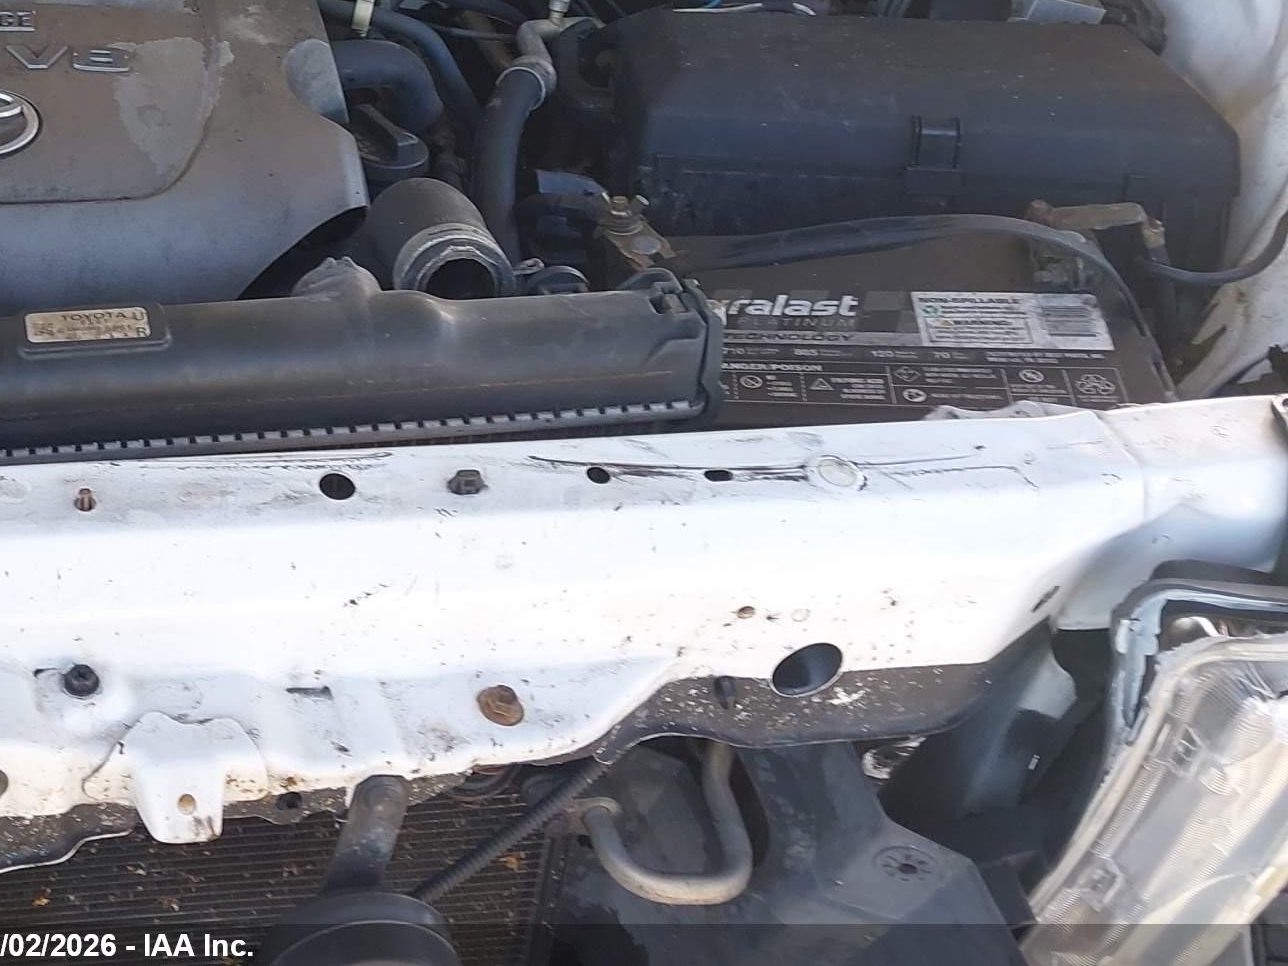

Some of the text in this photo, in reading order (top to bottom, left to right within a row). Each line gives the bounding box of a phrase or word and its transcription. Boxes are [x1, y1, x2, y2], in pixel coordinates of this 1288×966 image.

[6, 45, 129, 73] V8
[708, 295, 858, 316] ralast
[60, 311, 128, 322] TOYOTA
[737, 317, 856, 328] PLATINUM
